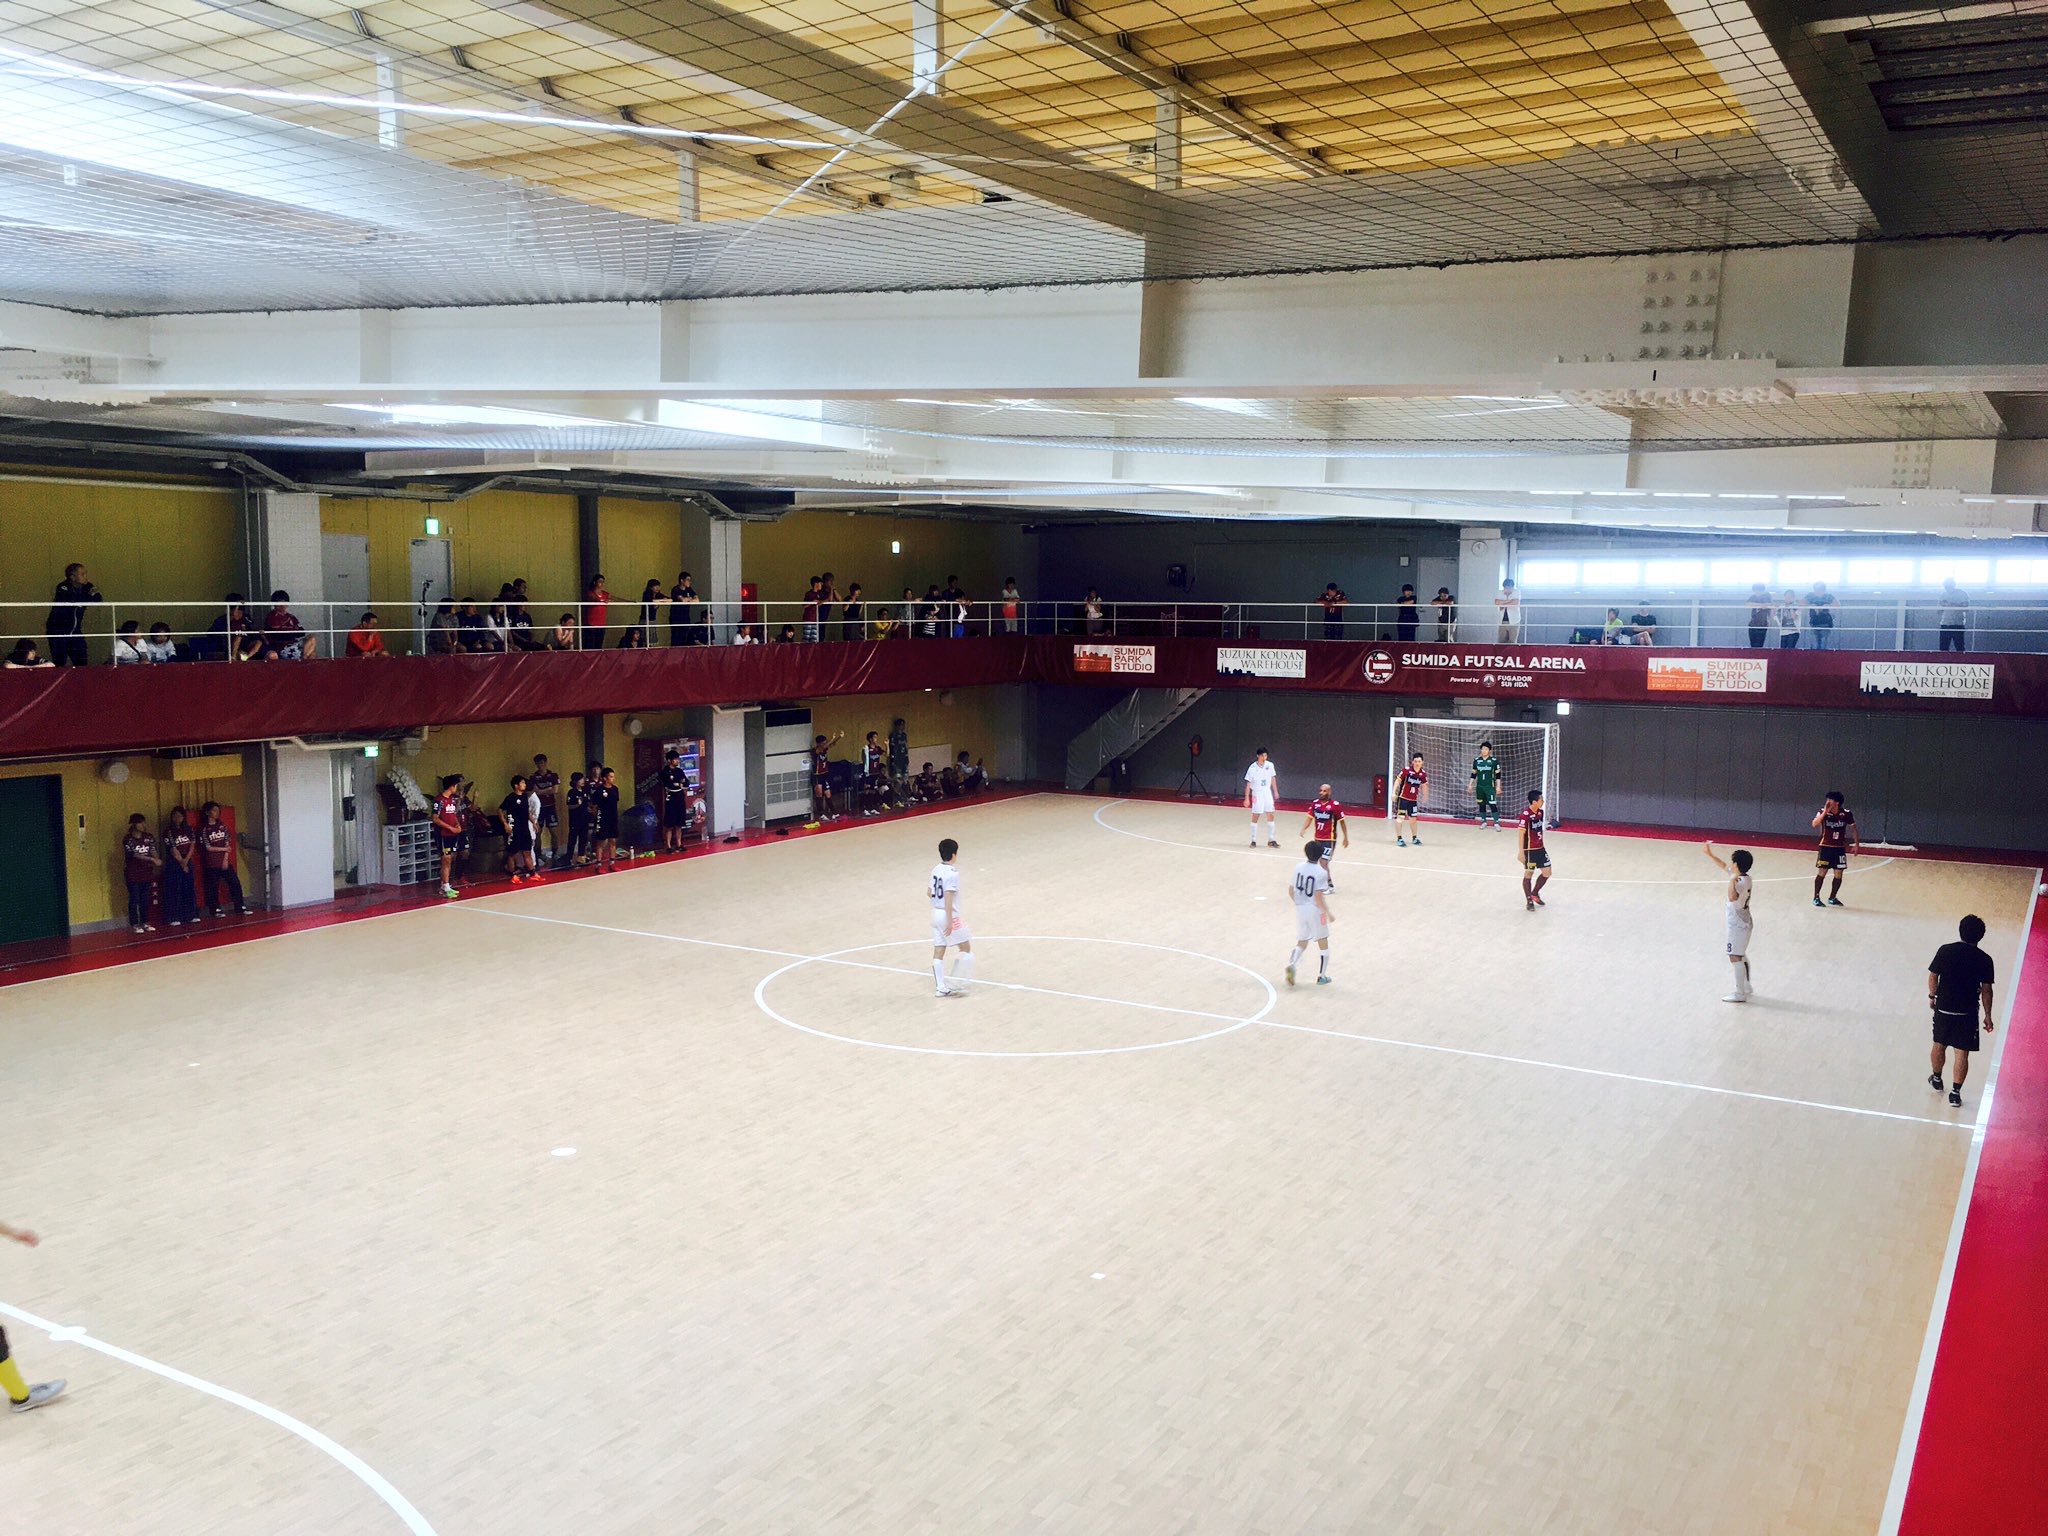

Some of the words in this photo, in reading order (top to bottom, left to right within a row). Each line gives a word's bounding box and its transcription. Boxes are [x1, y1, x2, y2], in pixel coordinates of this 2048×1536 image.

[1114, 647, 1152, 656] SUMIDA
[1219, 649, 1256, 659] SUZUKI
[1260, 650, 1304, 660] KOUSAN
[1114, 655, 1142, 663] PARK
[1240, 659, 1304, 670] WAREHOUSE
[1401, 653, 1460, 667] SUMIDA
[1464, 655, 1525, 668] FUTSAL
[1528, 656, 1586, 670] ARENA
[1114, 662, 1152, 671] STUDIO
[1706, 661, 1763, 671] SUMIDA
[1864, 664, 1918, 675] SUZUKI
[1925, 665, 1991, 678] KOUSAN
[1707, 671, 1747, 679] PARK
[1706, 679, 1763, 690] STUDIO
[1896, 676, 1990, 690] WAREHOUSE
[932, 875, 944, 899] 38
[1296, 872, 1315, 897] 40
